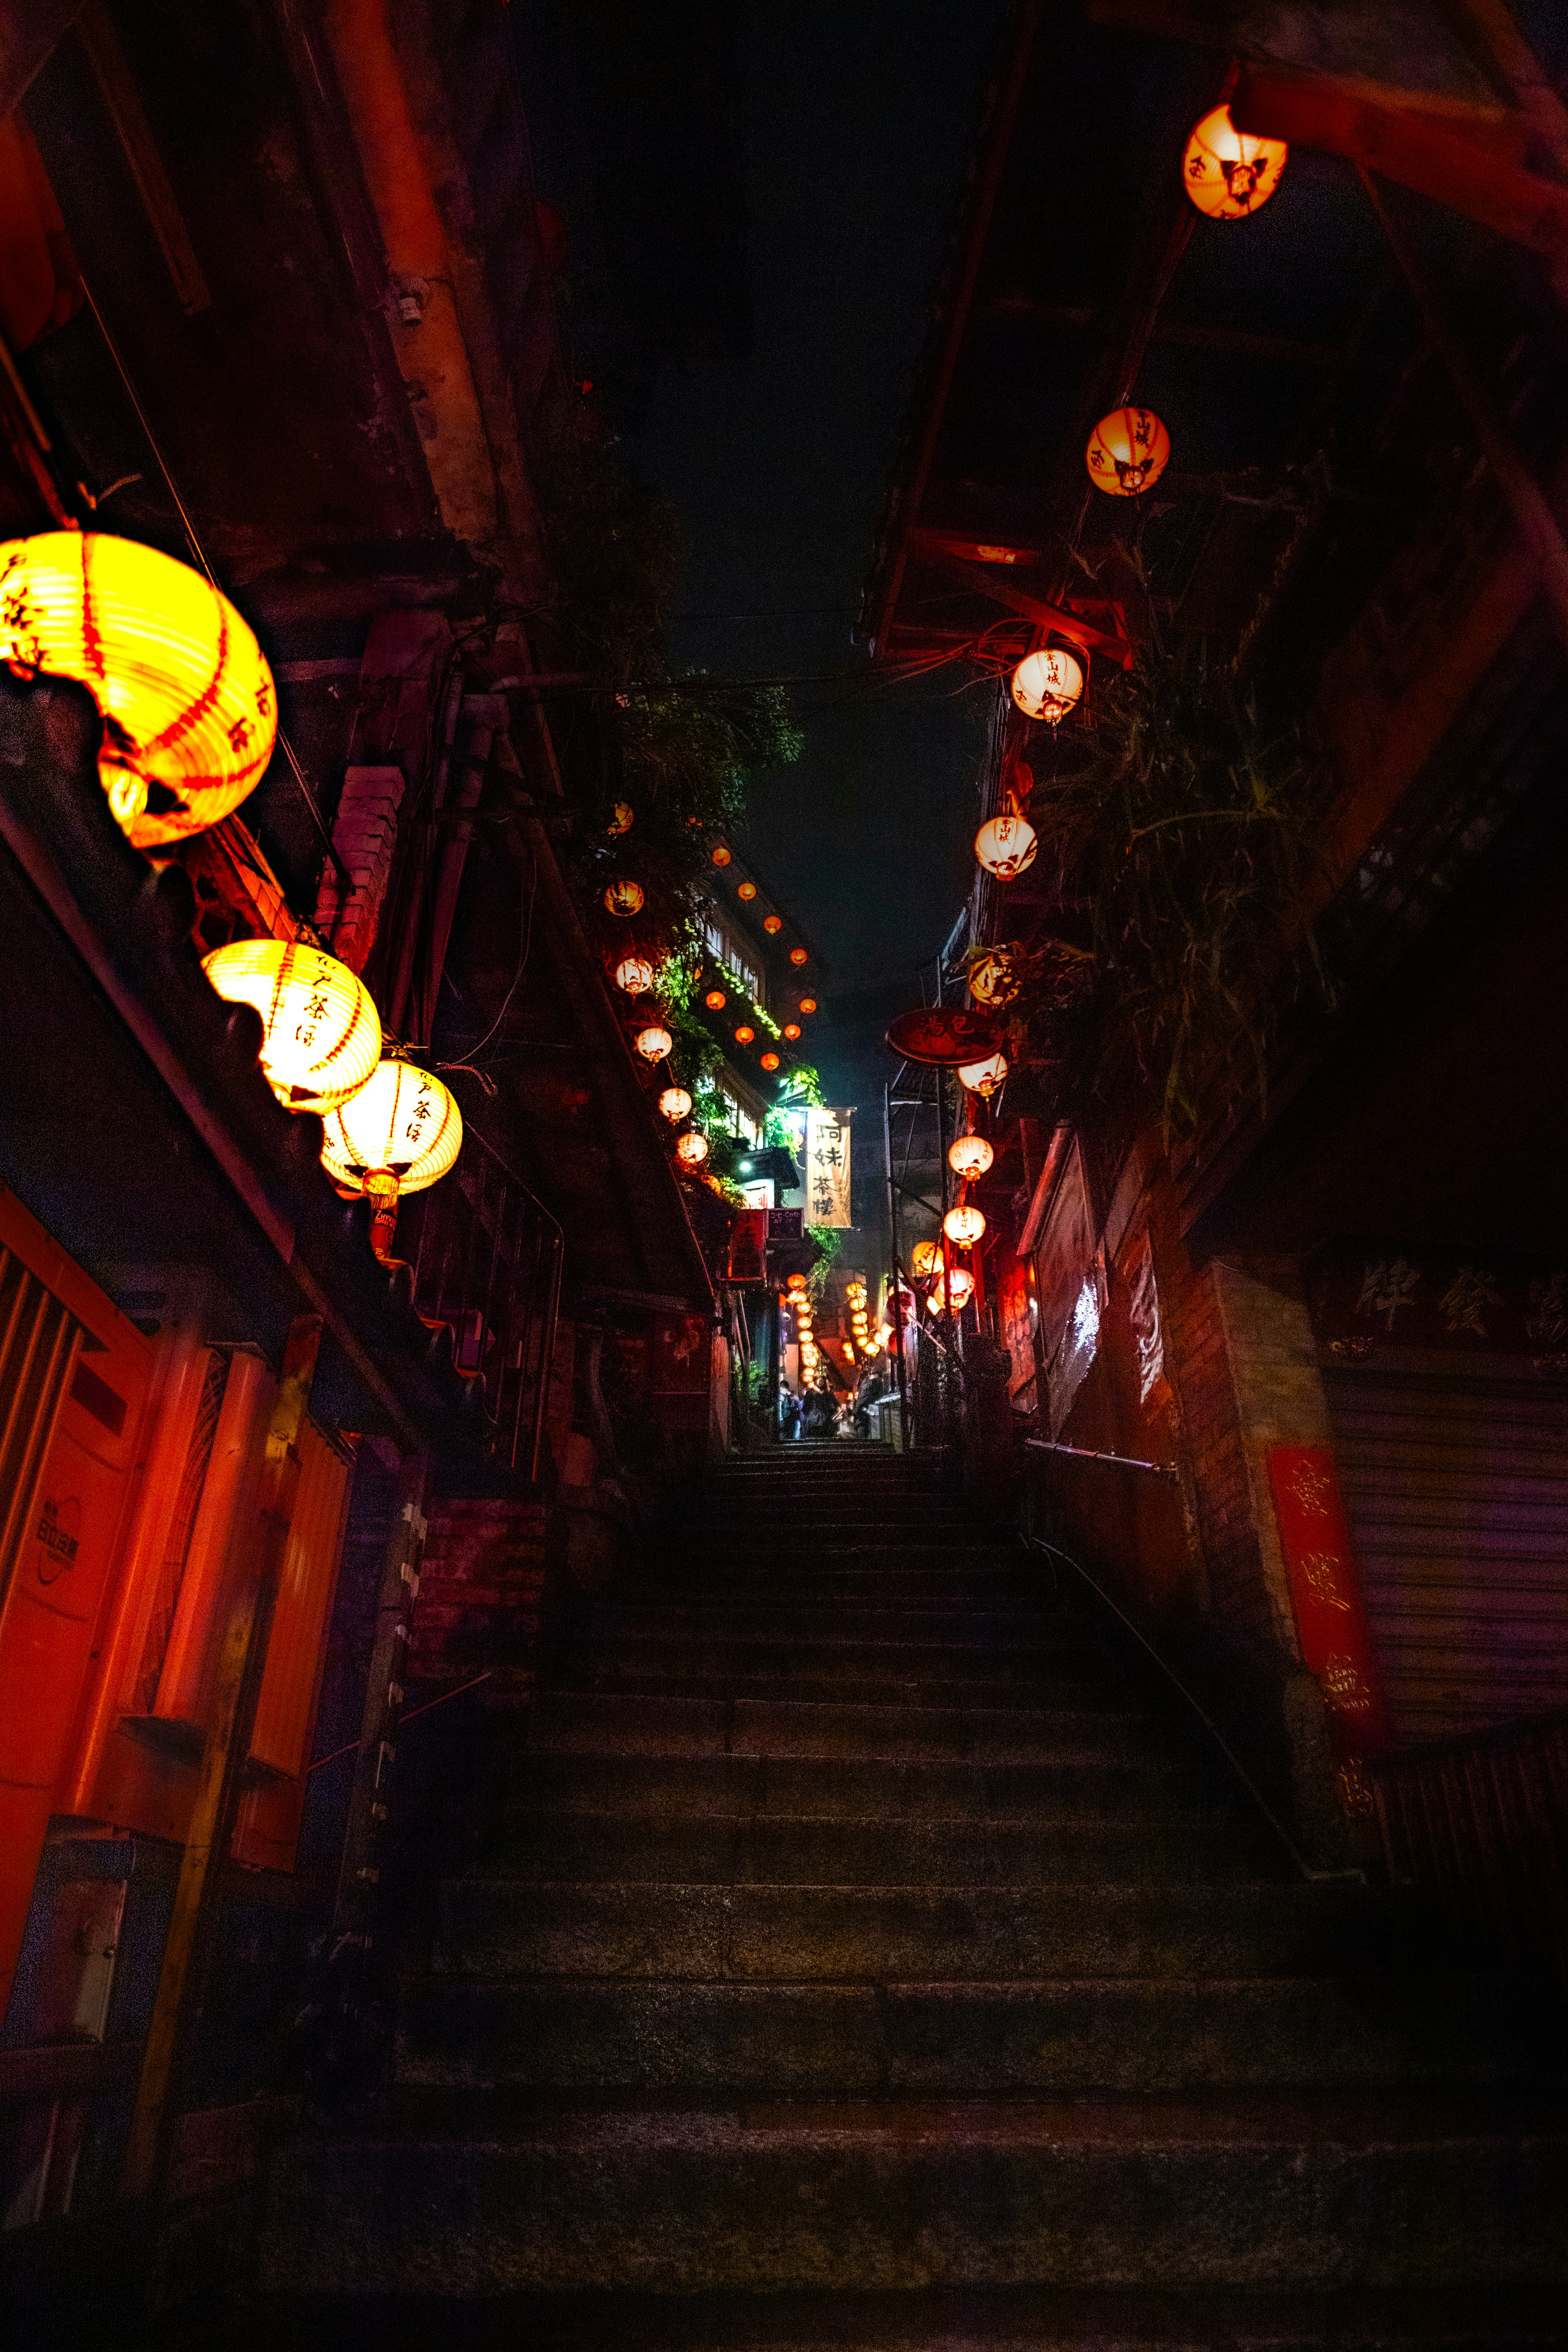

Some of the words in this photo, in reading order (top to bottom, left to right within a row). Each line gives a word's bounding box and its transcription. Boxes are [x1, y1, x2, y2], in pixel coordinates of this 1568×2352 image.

[920, 1016, 975, 1036] 湯包
[812, 1124, 843, 1216] 阿妹茶樓
